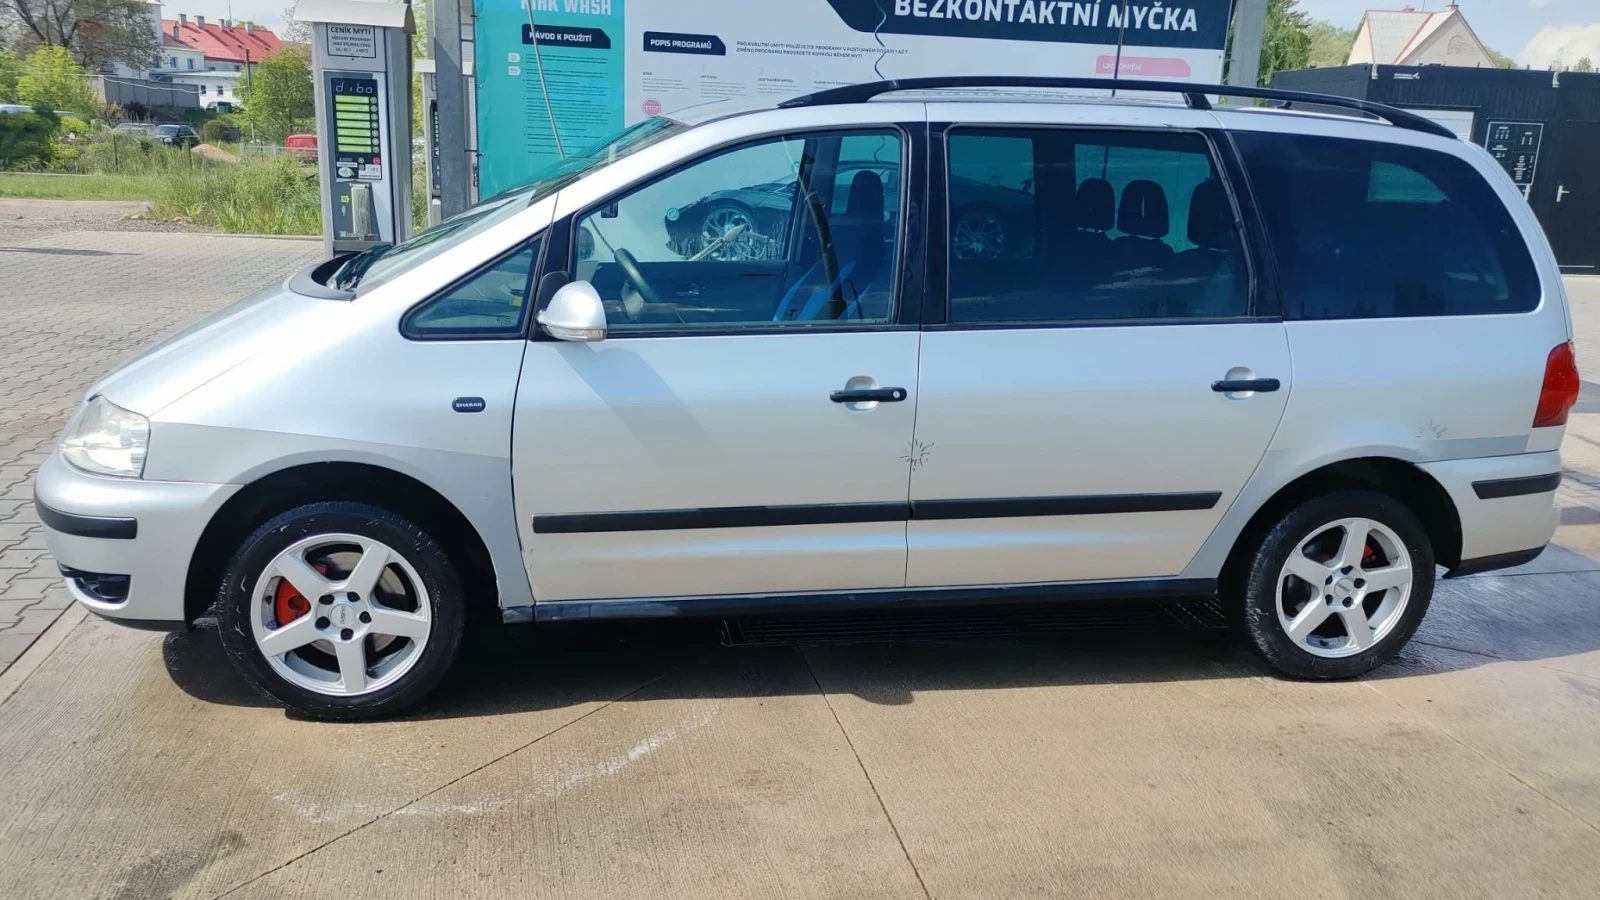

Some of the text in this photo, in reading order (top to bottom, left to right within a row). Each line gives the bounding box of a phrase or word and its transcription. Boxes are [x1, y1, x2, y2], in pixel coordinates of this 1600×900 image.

[894, 0, 1198, 32] BEZKONTAKTNÍ MYČKA
[330, 26, 371, 35] CENÍK MYTÍ
[529, 31, 592, 42] NÁVOD K POUŽITÍ
[650, 38, 712, 50] POPIS PROGRAMŮ
[1102, 61, 1142, 71] UPOORNĚNÍ
